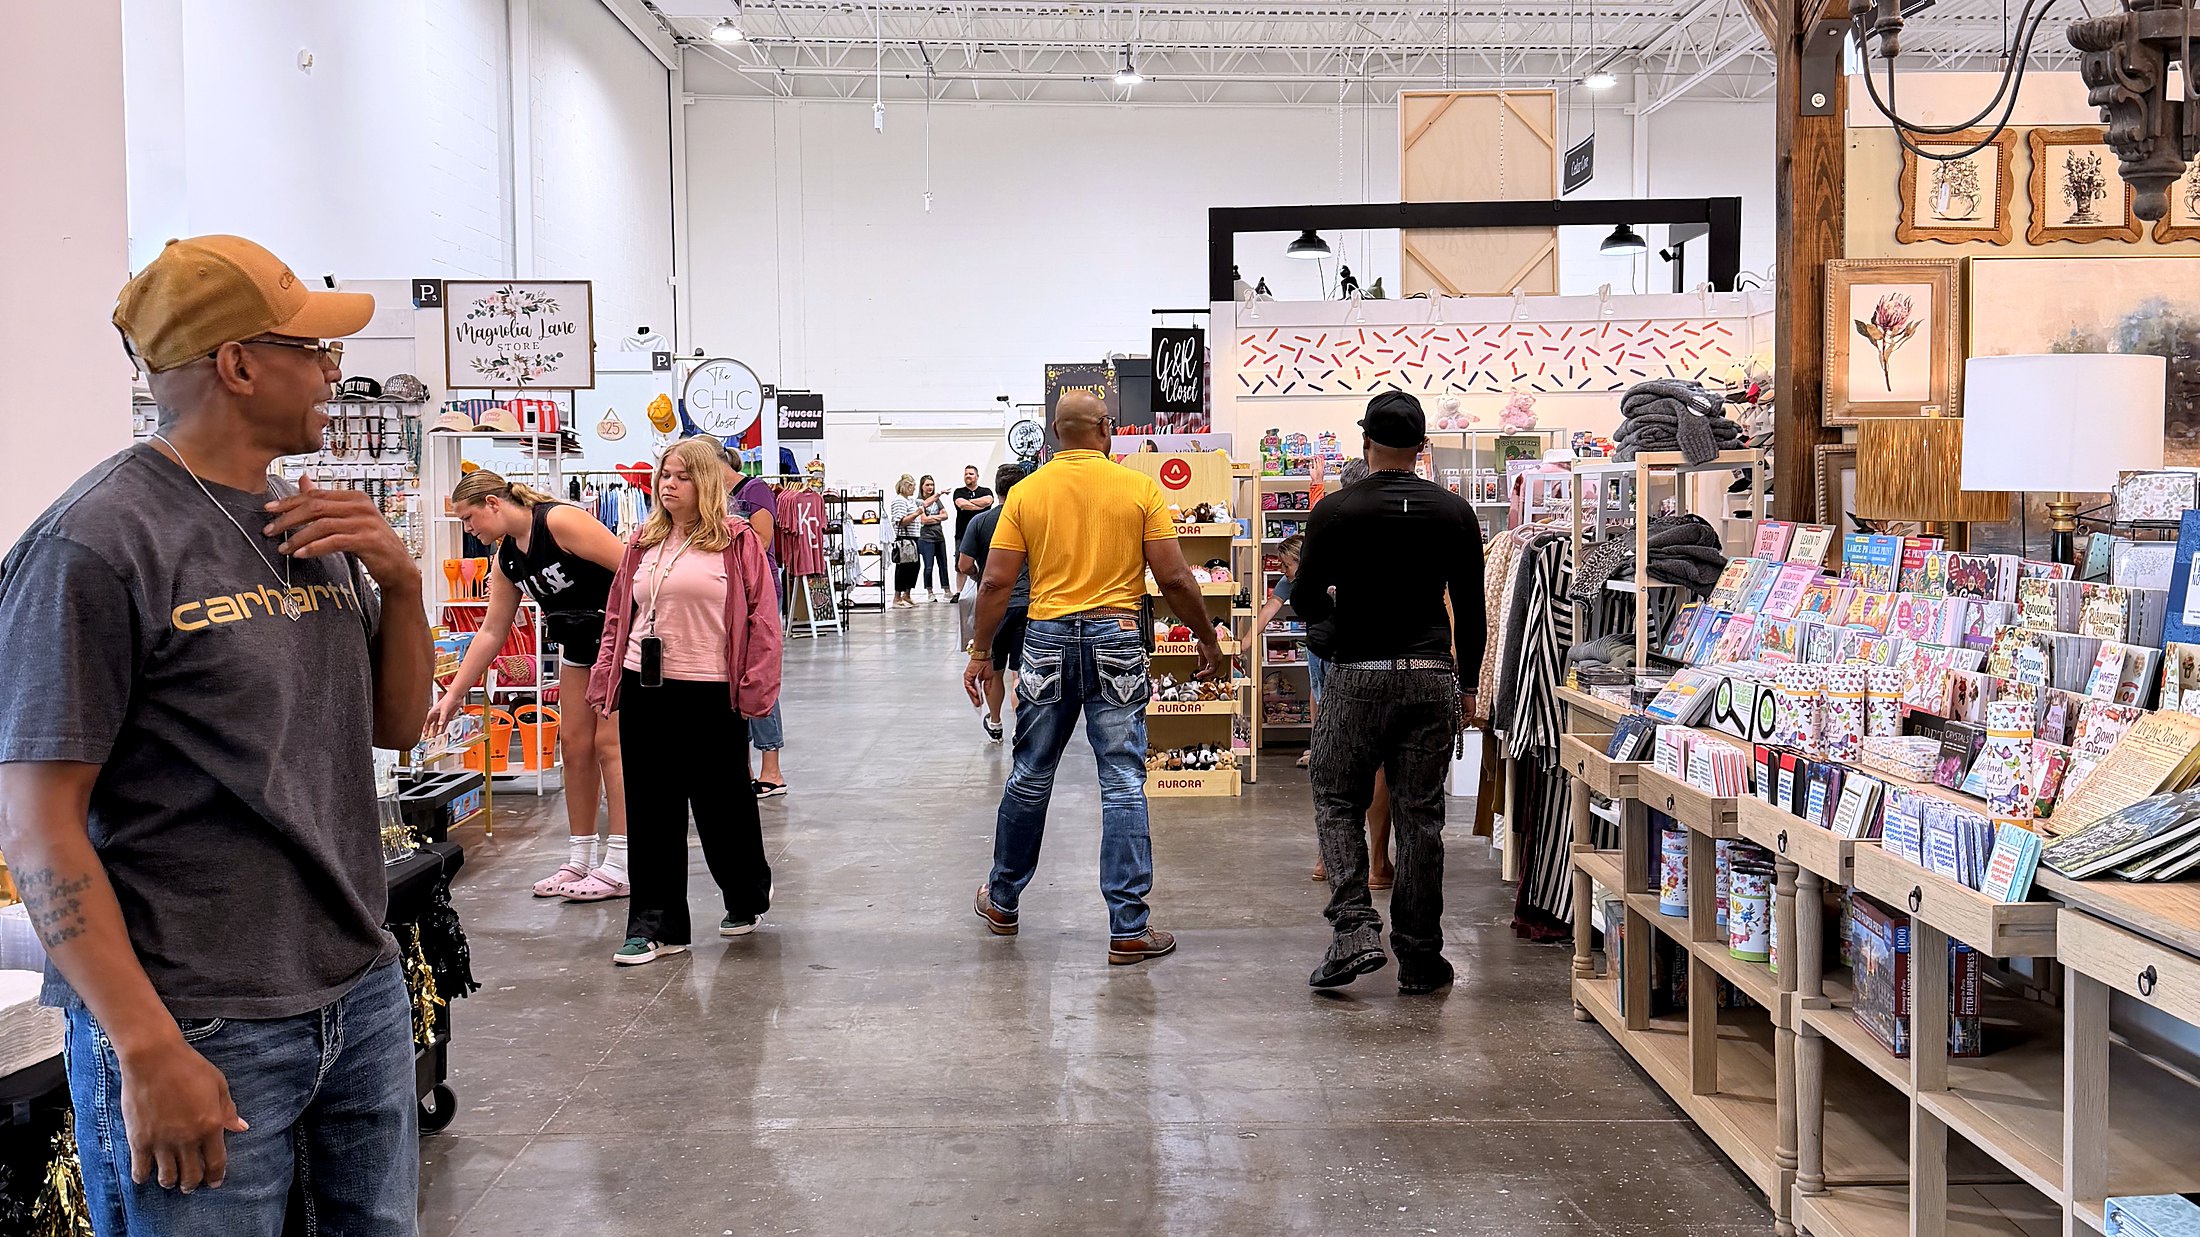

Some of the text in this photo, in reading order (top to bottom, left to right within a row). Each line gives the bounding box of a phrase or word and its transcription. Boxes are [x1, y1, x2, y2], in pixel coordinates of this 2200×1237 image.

[456, 318, 576, 346] Magnolia Lane
[497, 342, 540, 351] STORE
[1156, 336, 1196, 391] G&R
[706, 366, 731, 386] The
[692, 388, 753, 410] CHIC
[1165, 376, 1198, 403] Closet
[704, 410, 741, 431] Closet
[778, 405, 822, 419] SNUGGLE
[600, 421, 620, 435] $25
[778, 417, 818, 429] BUGGIN
[1176, 525, 1201, 535] ORA
[1157, 703, 1203, 713] AURORA
[1945, 729, 1970, 744] CRYSTALS
[2094, 726, 2114, 745] BOHO
[1157, 779, 1203, 789] AURORA
[1898, 928, 1906, 950] 1000
[1966, 952, 1975, 1015] PETER PAUPER PRESS
